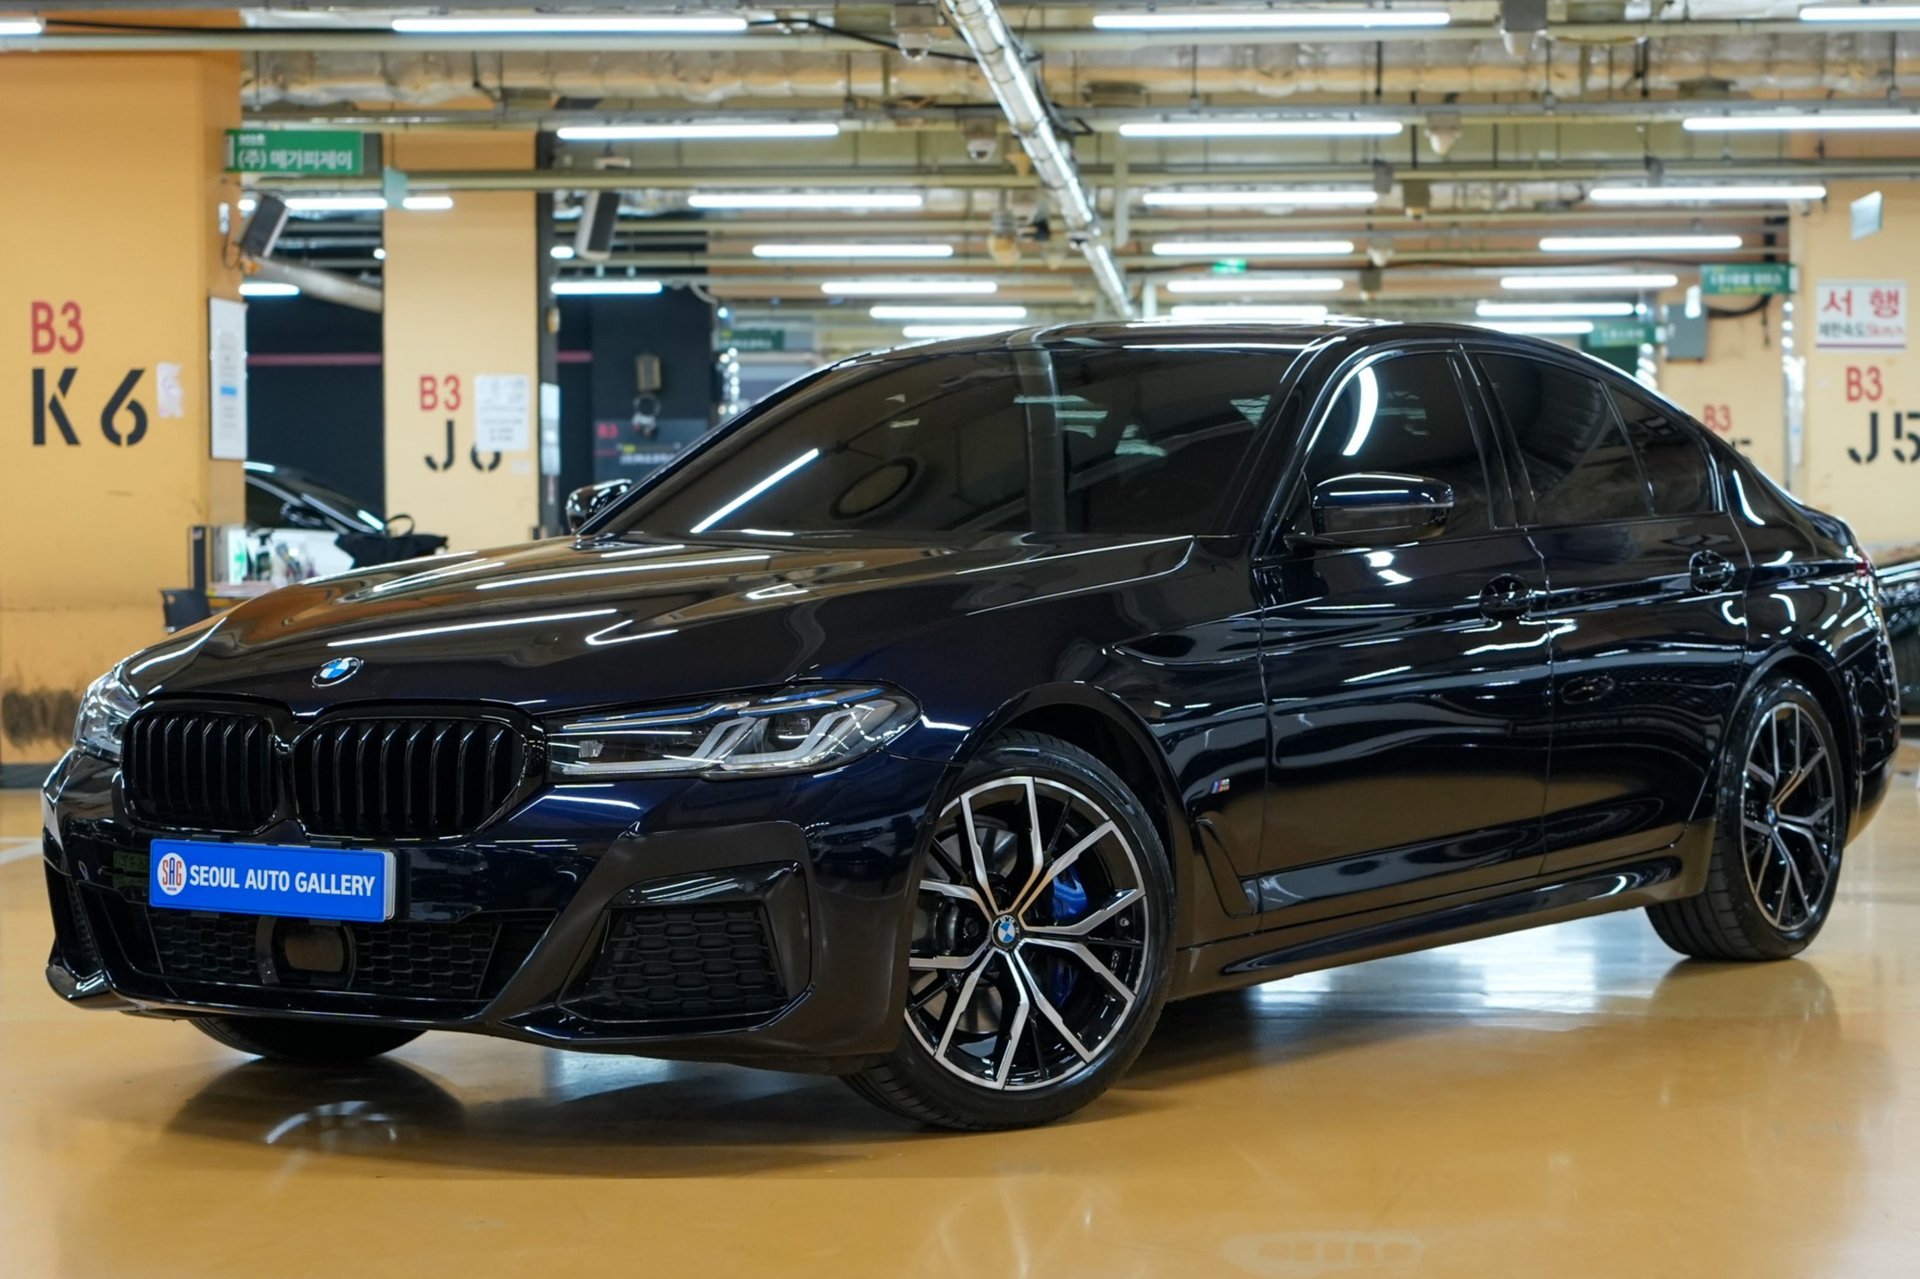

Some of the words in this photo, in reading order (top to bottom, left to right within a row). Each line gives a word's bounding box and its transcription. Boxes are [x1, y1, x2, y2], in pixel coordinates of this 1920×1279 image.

[32, 301, 84, 354] B3
[420, 375, 461, 411] B3
[1846, 366, 1883, 402] B3
[1704, 404, 1731, 431] B3
[162, 857, 182, 886] SAG
[189, 864, 240, 889] SEOUL
[244, 869, 290, 892] AUTO
[295, 872, 376, 897] GALLERY
